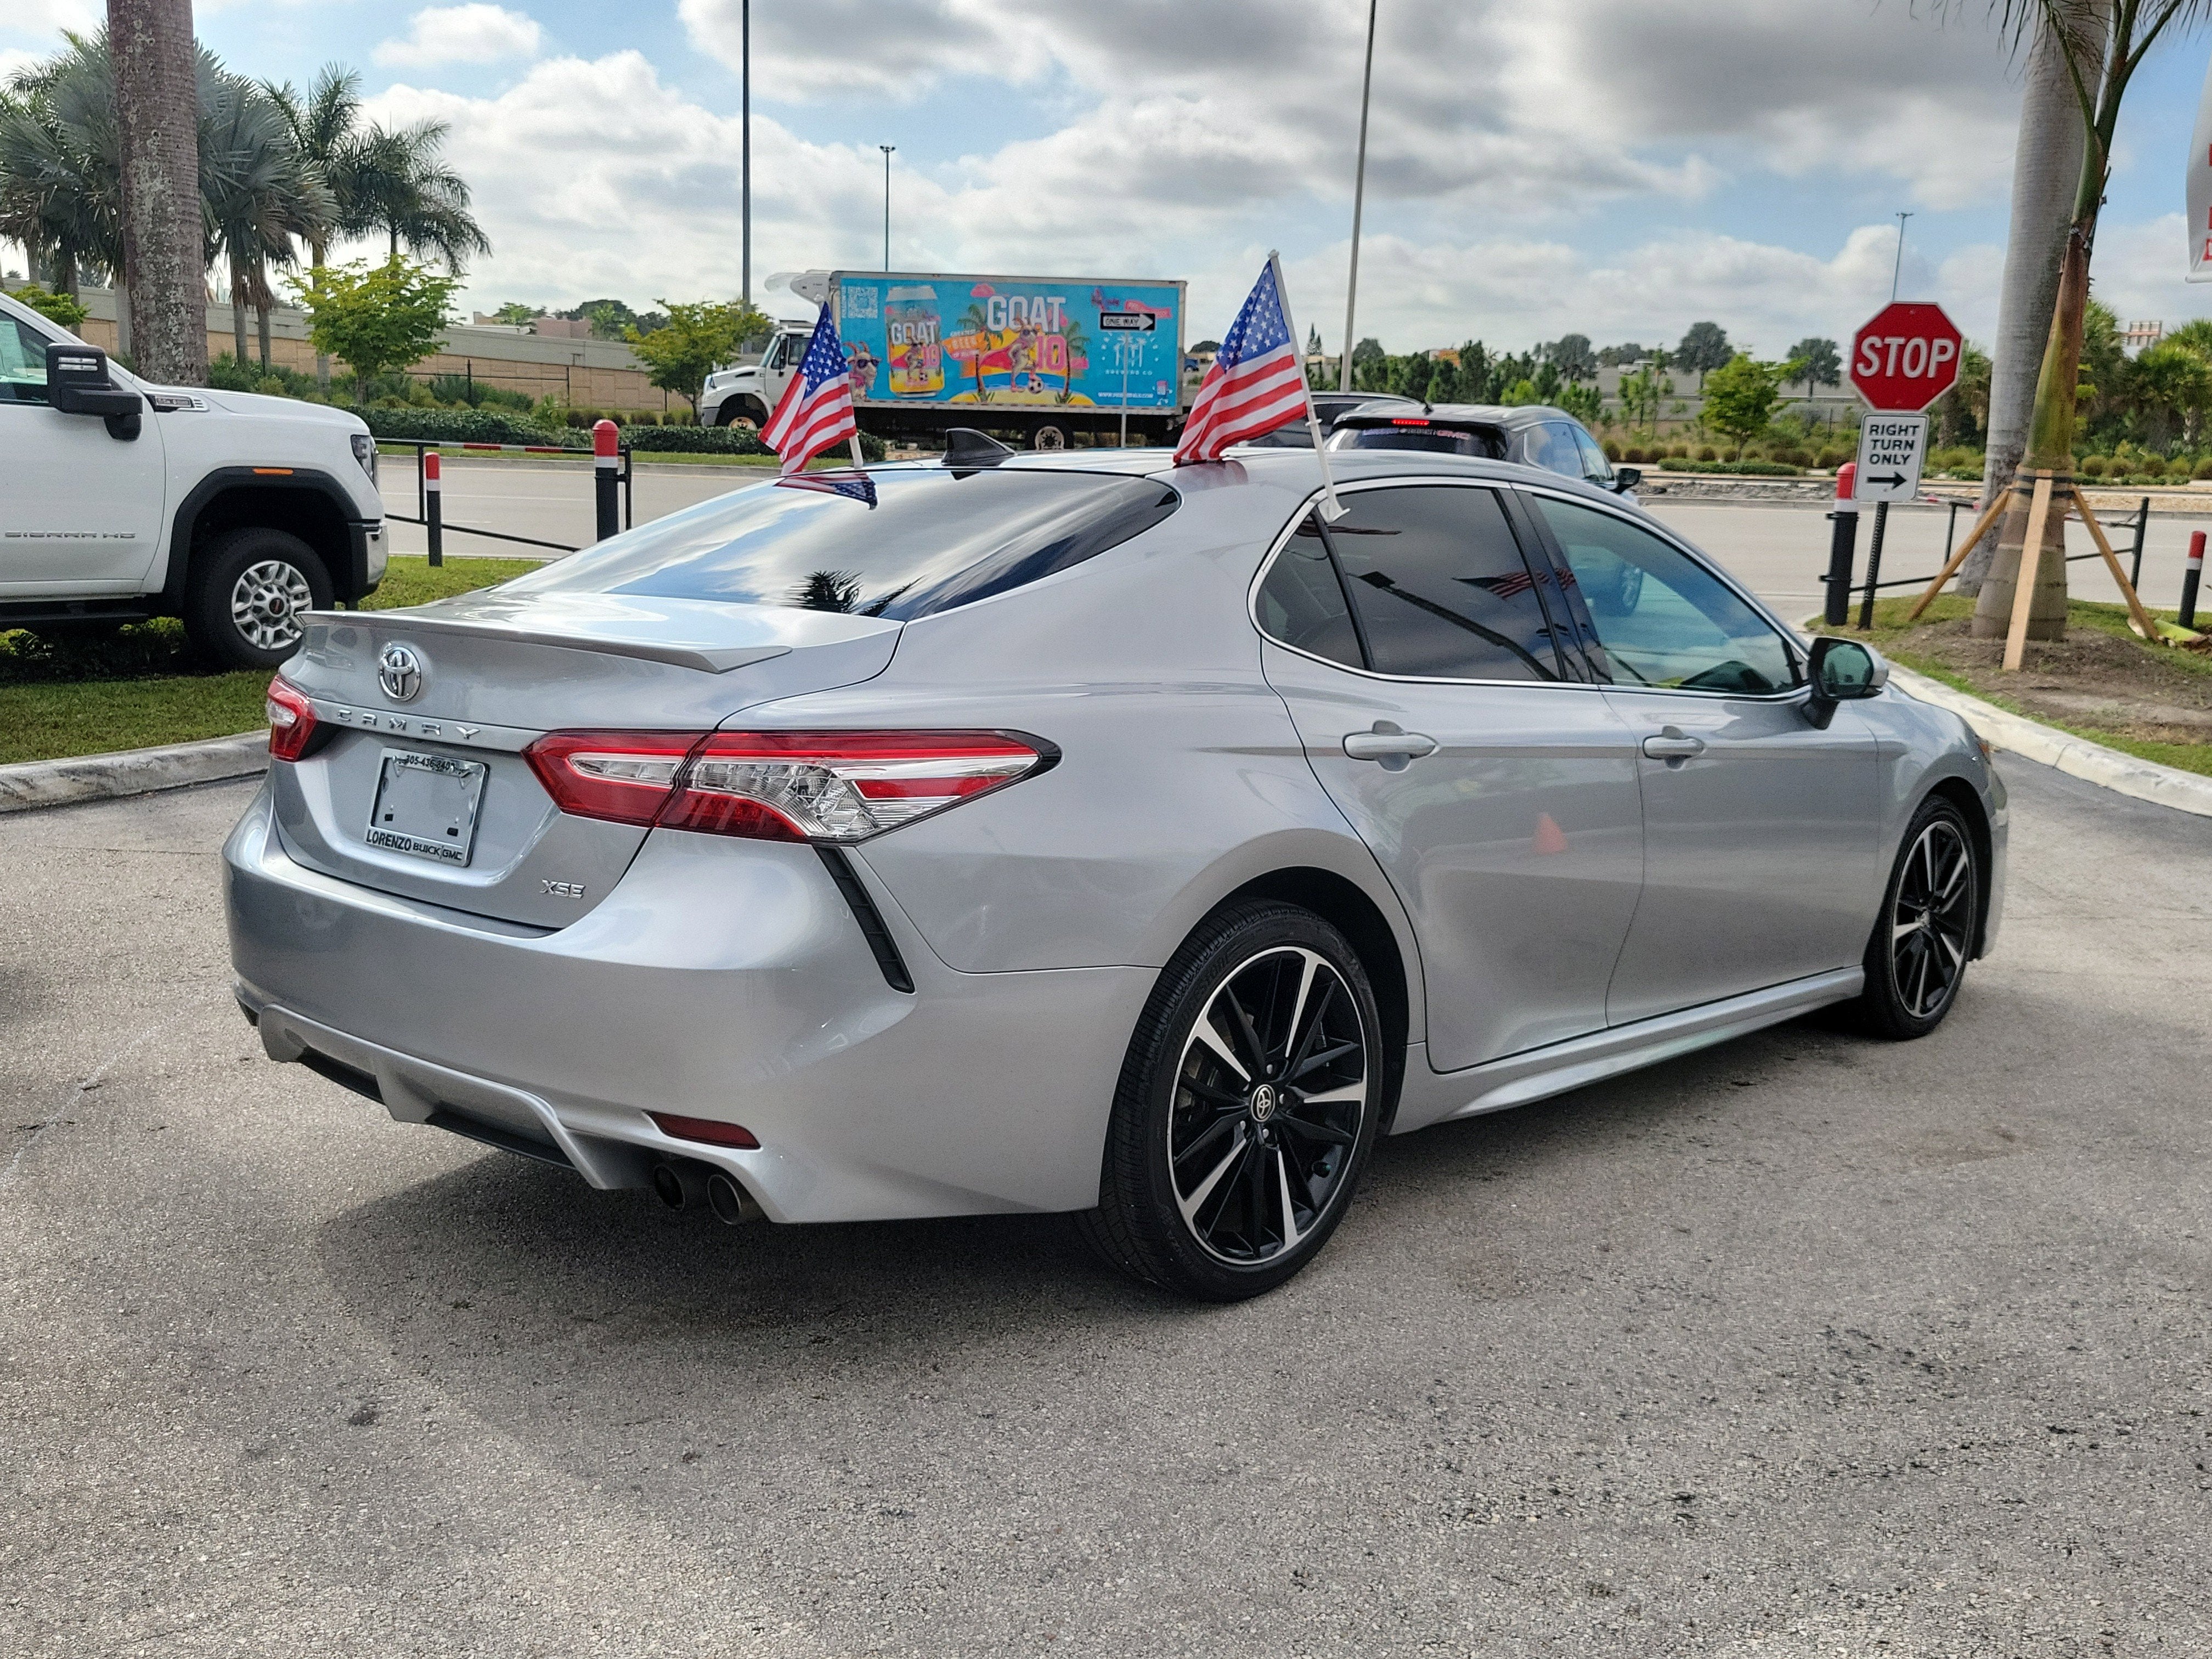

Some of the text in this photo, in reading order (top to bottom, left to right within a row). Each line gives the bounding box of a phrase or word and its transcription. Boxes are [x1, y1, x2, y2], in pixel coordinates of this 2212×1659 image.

[988, 296, 1065, 332] GOAT
[1105, 318, 1139, 326] ONE WAY
[891, 321, 936, 345] GOAT
[1036, 334, 1068, 371] 10
[1857, 336, 1955, 378] STOP
[1869, 424, 1920, 436] RIGHT
[1870, 439, 1915, 451] TURN
[1870, 454, 1910, 465] ONLY
[338, 709, 481, 740] CAMRY
[366, 830, 463, 860] LORENZO BUICK GMC
[539, 878, 586, 899] XSE
